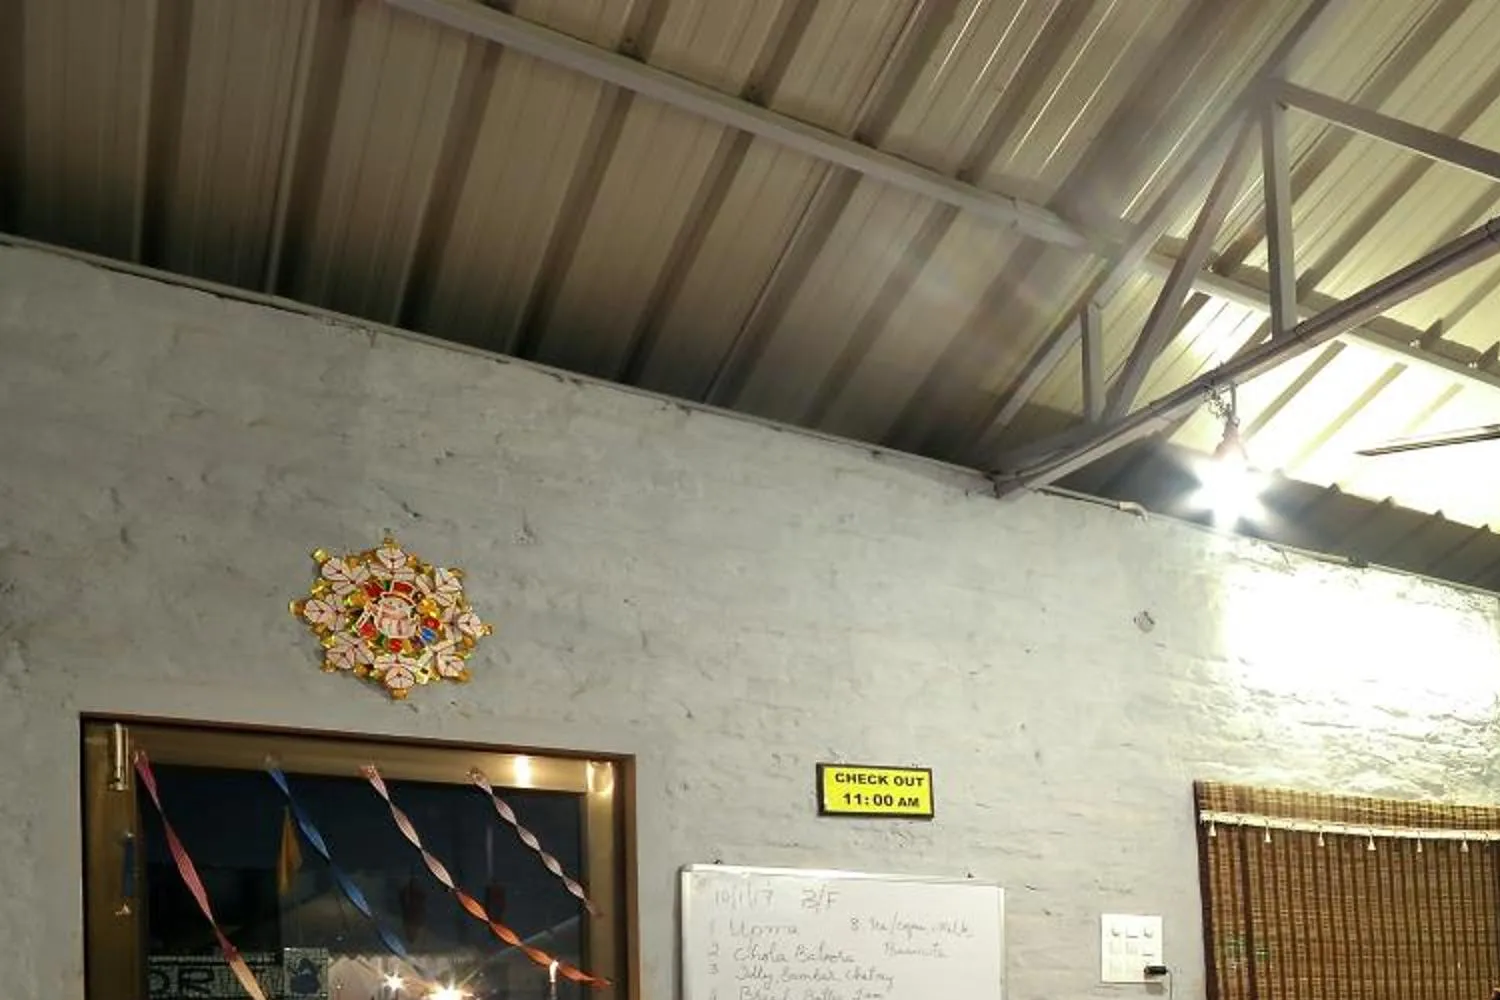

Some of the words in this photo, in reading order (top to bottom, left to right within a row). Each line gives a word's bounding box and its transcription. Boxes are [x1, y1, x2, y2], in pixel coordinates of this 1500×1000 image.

[834, 772, 889, 785] CHECK
[893, 776, 924, 787] OUT
[842, 792, 894, 807] 11:00
[897, 797, 921, 808] AM
